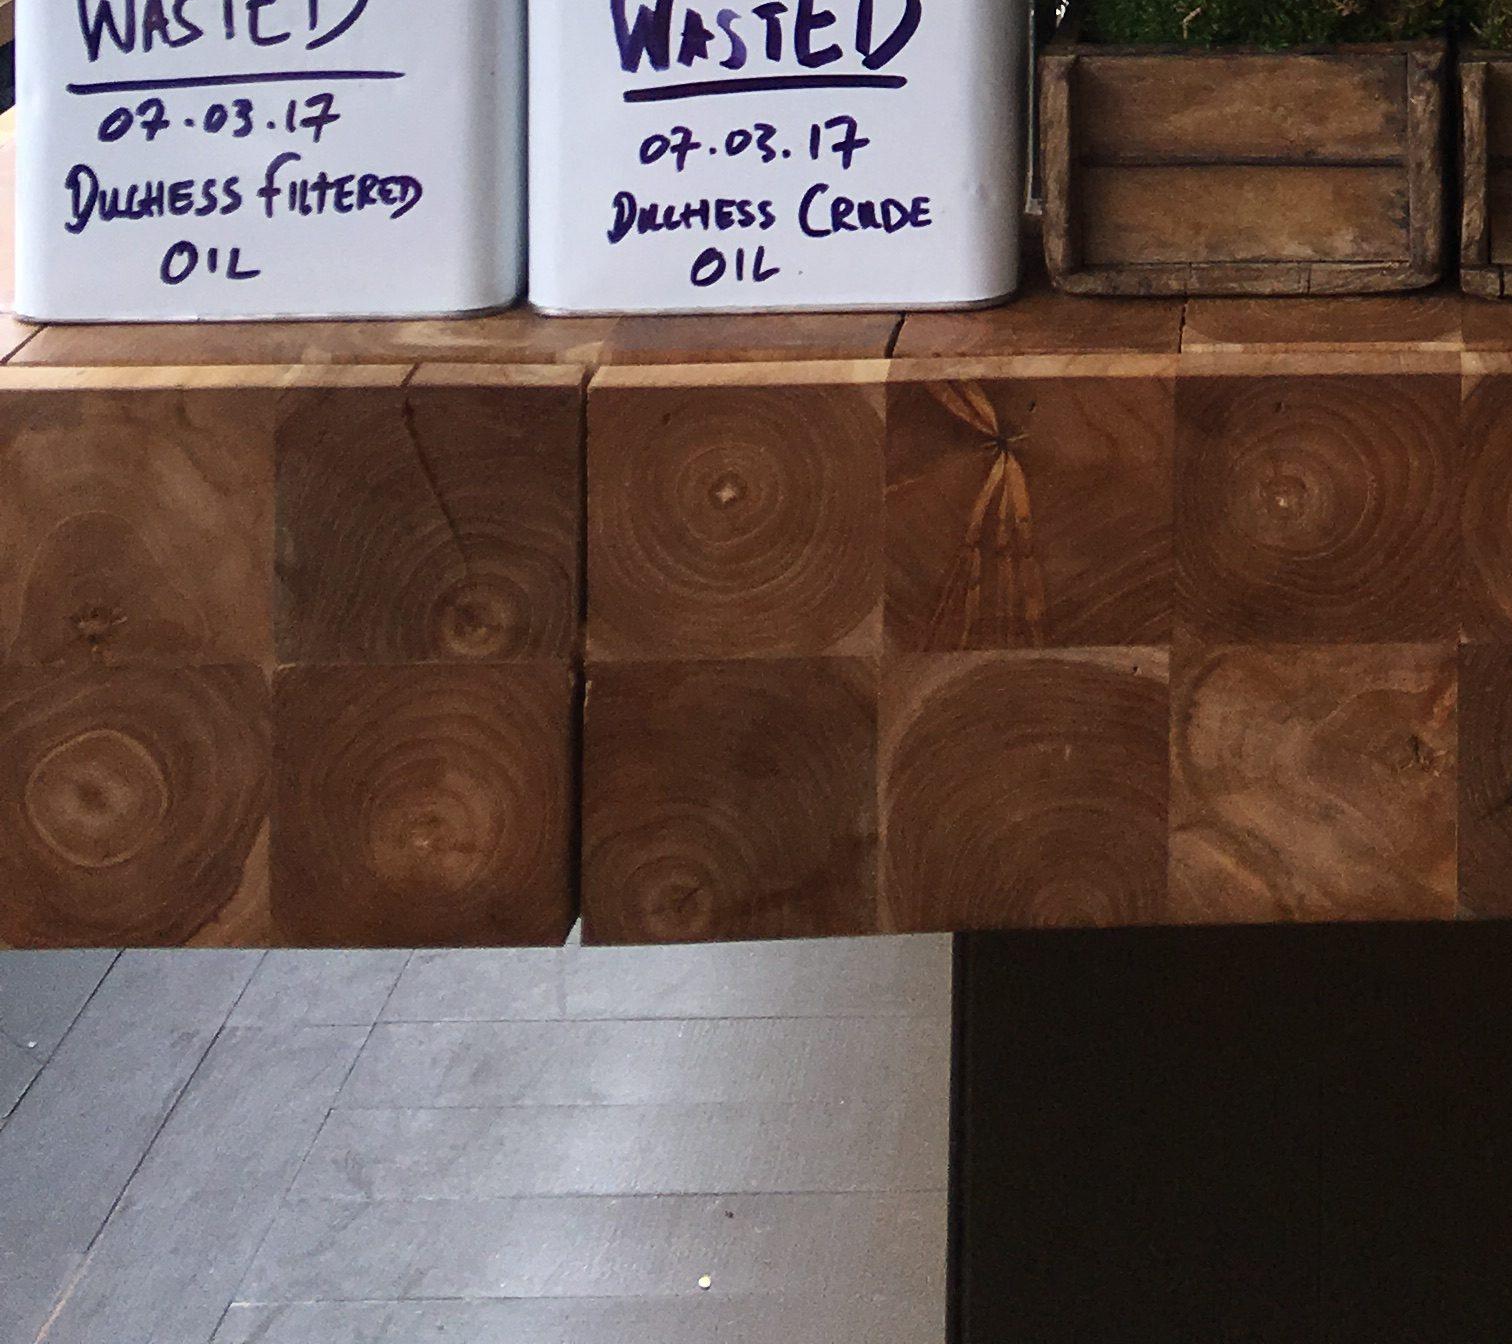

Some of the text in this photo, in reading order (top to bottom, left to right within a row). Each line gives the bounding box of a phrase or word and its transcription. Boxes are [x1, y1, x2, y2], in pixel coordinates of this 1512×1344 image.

[639, 115, 871, 172] 07.03.17
[64, 163, 243, 235] DUCHESS
[606, 182, 933, 245] DUCHESS CRUDE
[160, 239, 262, 286] OIL
[690, 245, 781, 288] OIL
